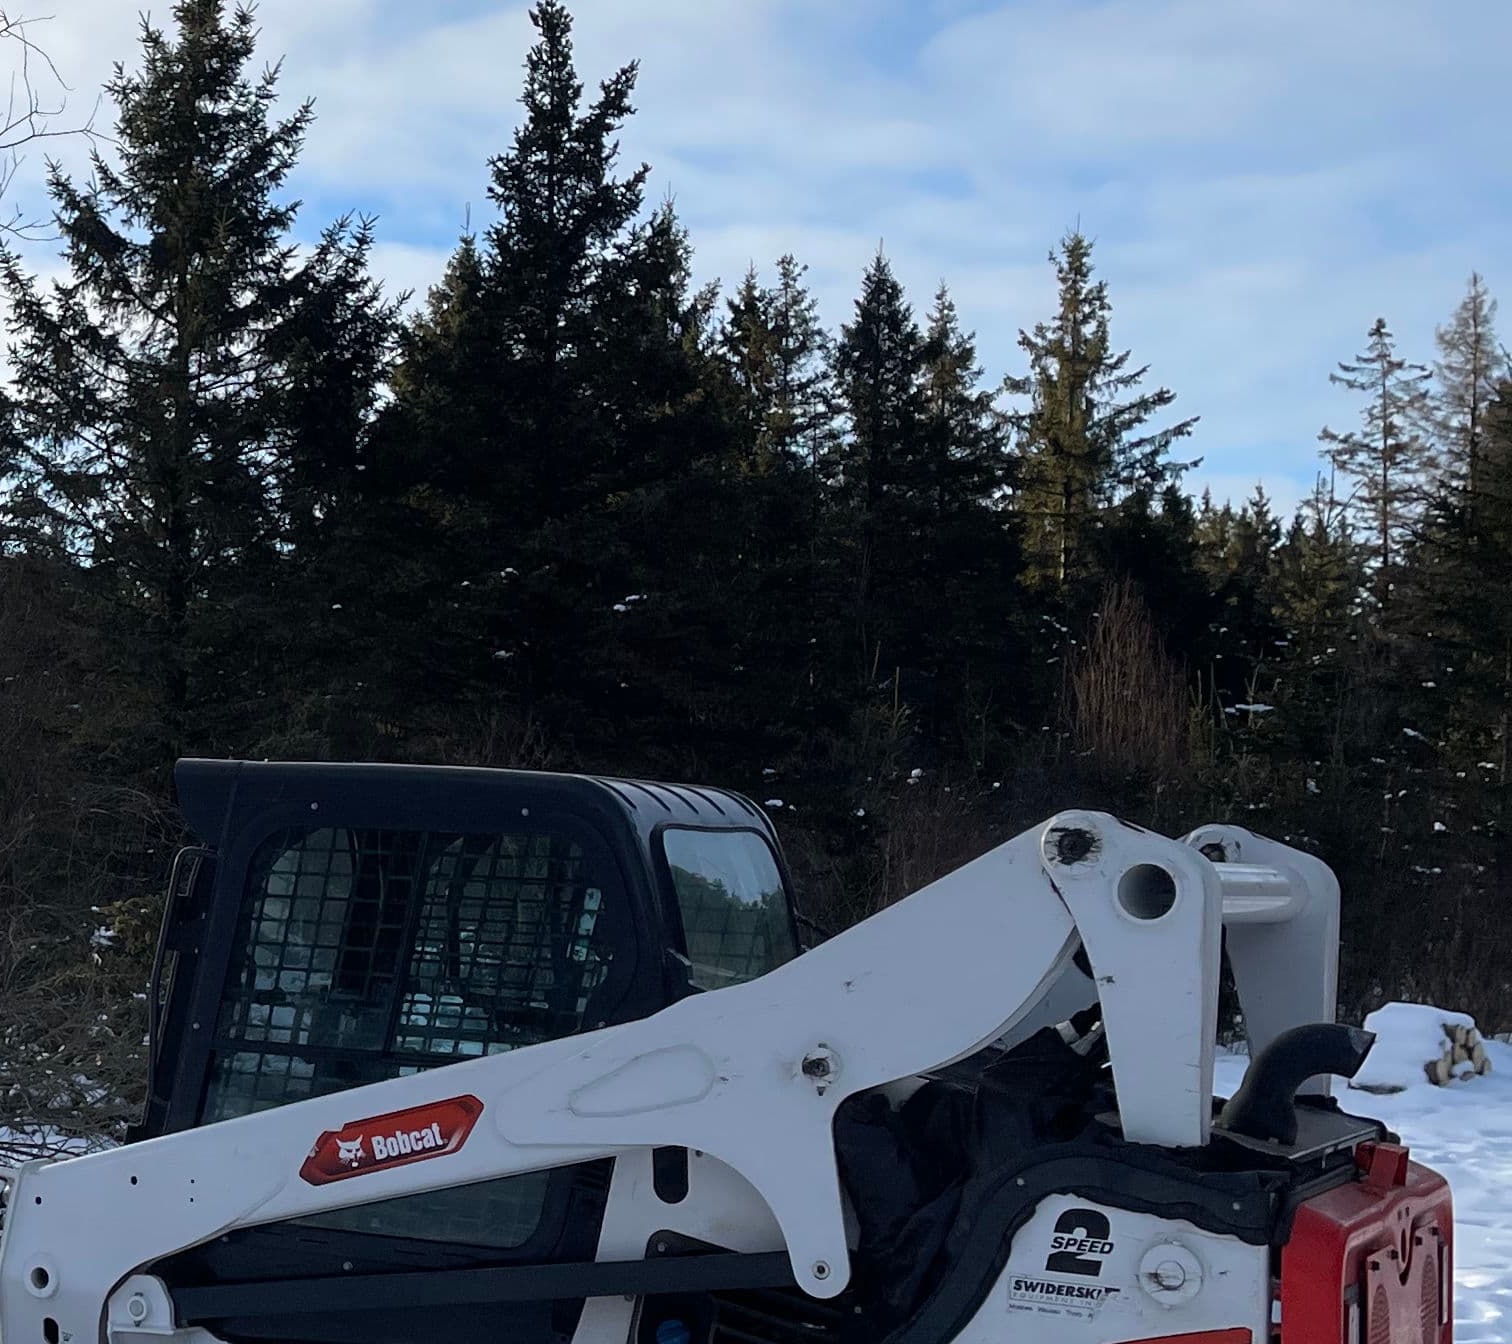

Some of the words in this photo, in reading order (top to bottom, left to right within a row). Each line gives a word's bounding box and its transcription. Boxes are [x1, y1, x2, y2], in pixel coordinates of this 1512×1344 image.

[371, 1122, 443, 1161] Bobcat
[1045, 1208, 1111, 1277] 2
[1050, 1236, 1115, 1255] SPEED
[1013, 1279, 1102, 1301] SWIDERSKI
